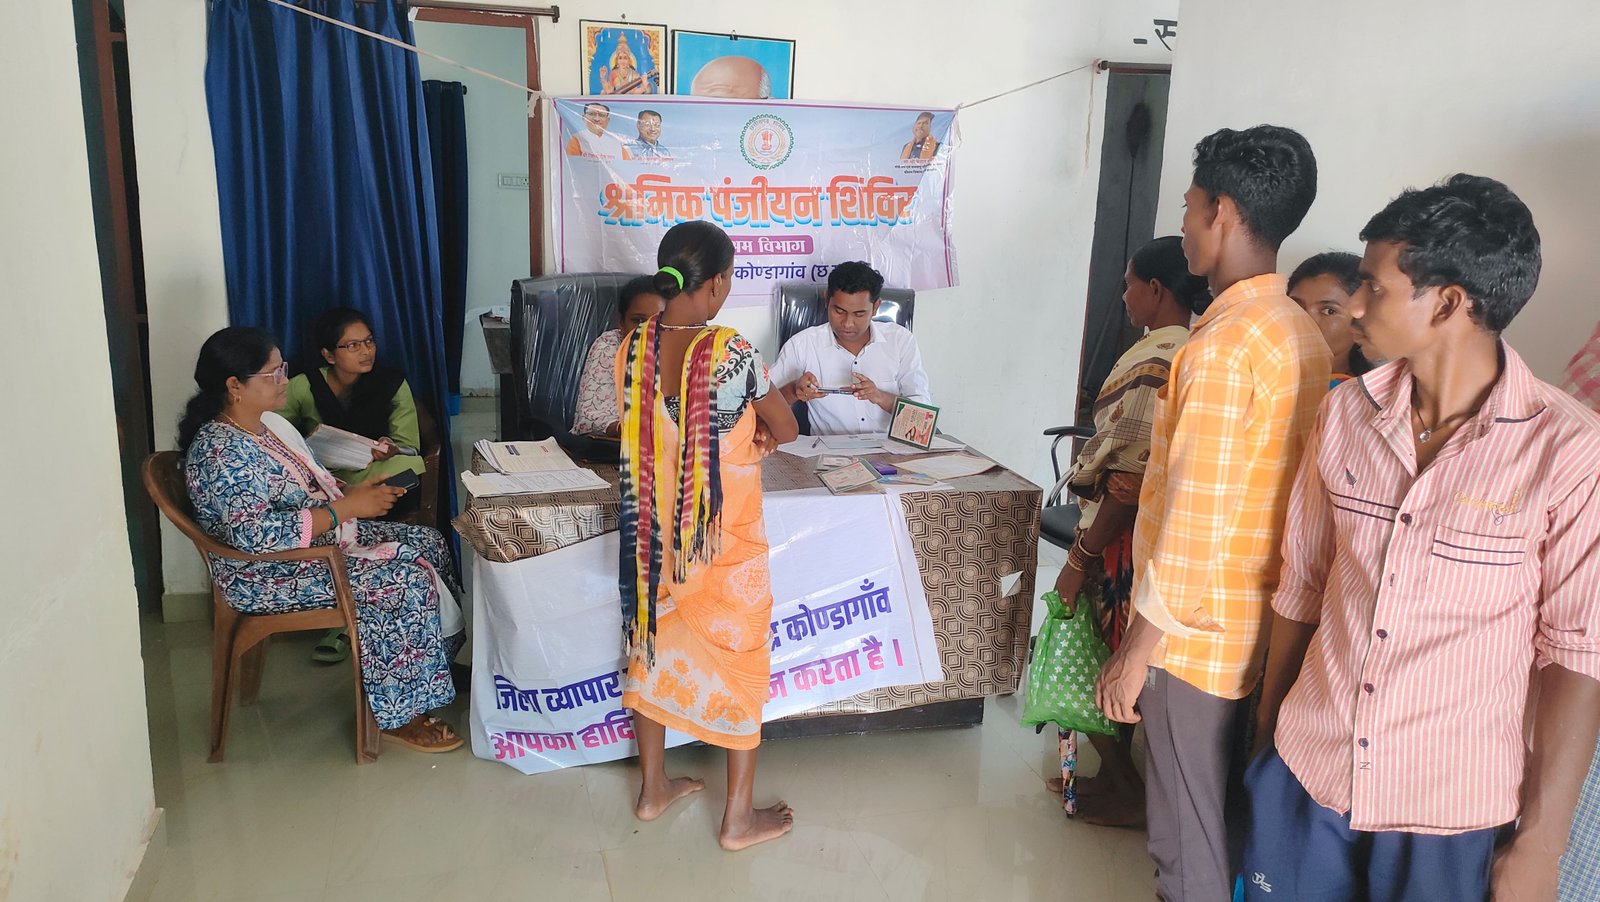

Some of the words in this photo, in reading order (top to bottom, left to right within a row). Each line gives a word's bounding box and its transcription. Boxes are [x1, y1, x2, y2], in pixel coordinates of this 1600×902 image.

[599, 174, 705, 227] श्रमिक
[707, 176, 822, 228] पंजीयन
[734, 261, 807, 280] कोण्डागांव
[757, 236, 806, 253] विभाग
[493, 674, 543, 714] जिला
[541, 670, 623, 712] व्यापार
[781, 578, 893, 642] कोण्डागाँव
[490, 731, 577, 760] आपका
[788, 649, 862, 692] करता
[861, 634, 885, 671] है
